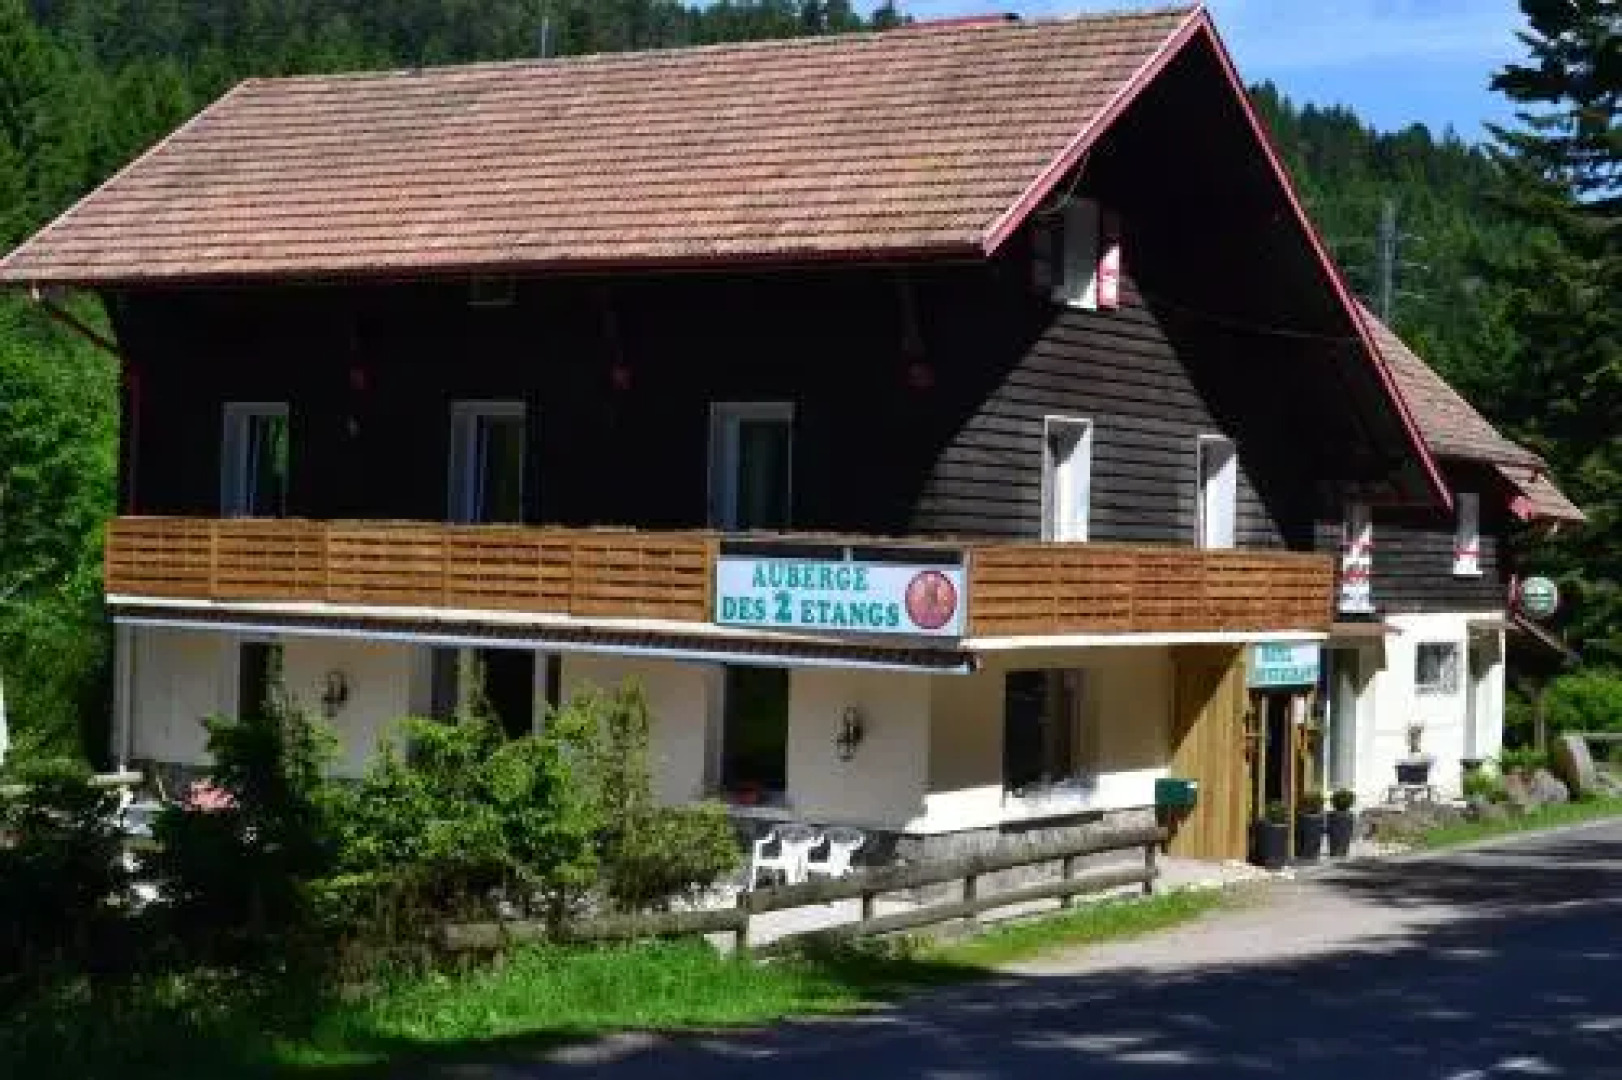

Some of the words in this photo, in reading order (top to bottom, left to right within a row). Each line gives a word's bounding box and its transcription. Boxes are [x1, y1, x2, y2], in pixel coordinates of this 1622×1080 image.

[752, 562, 869, 590] AUBERGE
[722, 597, 766, 620] DES
[774, 591, 792, 622] 2
[800, 600, 900, 627] ETANGS
